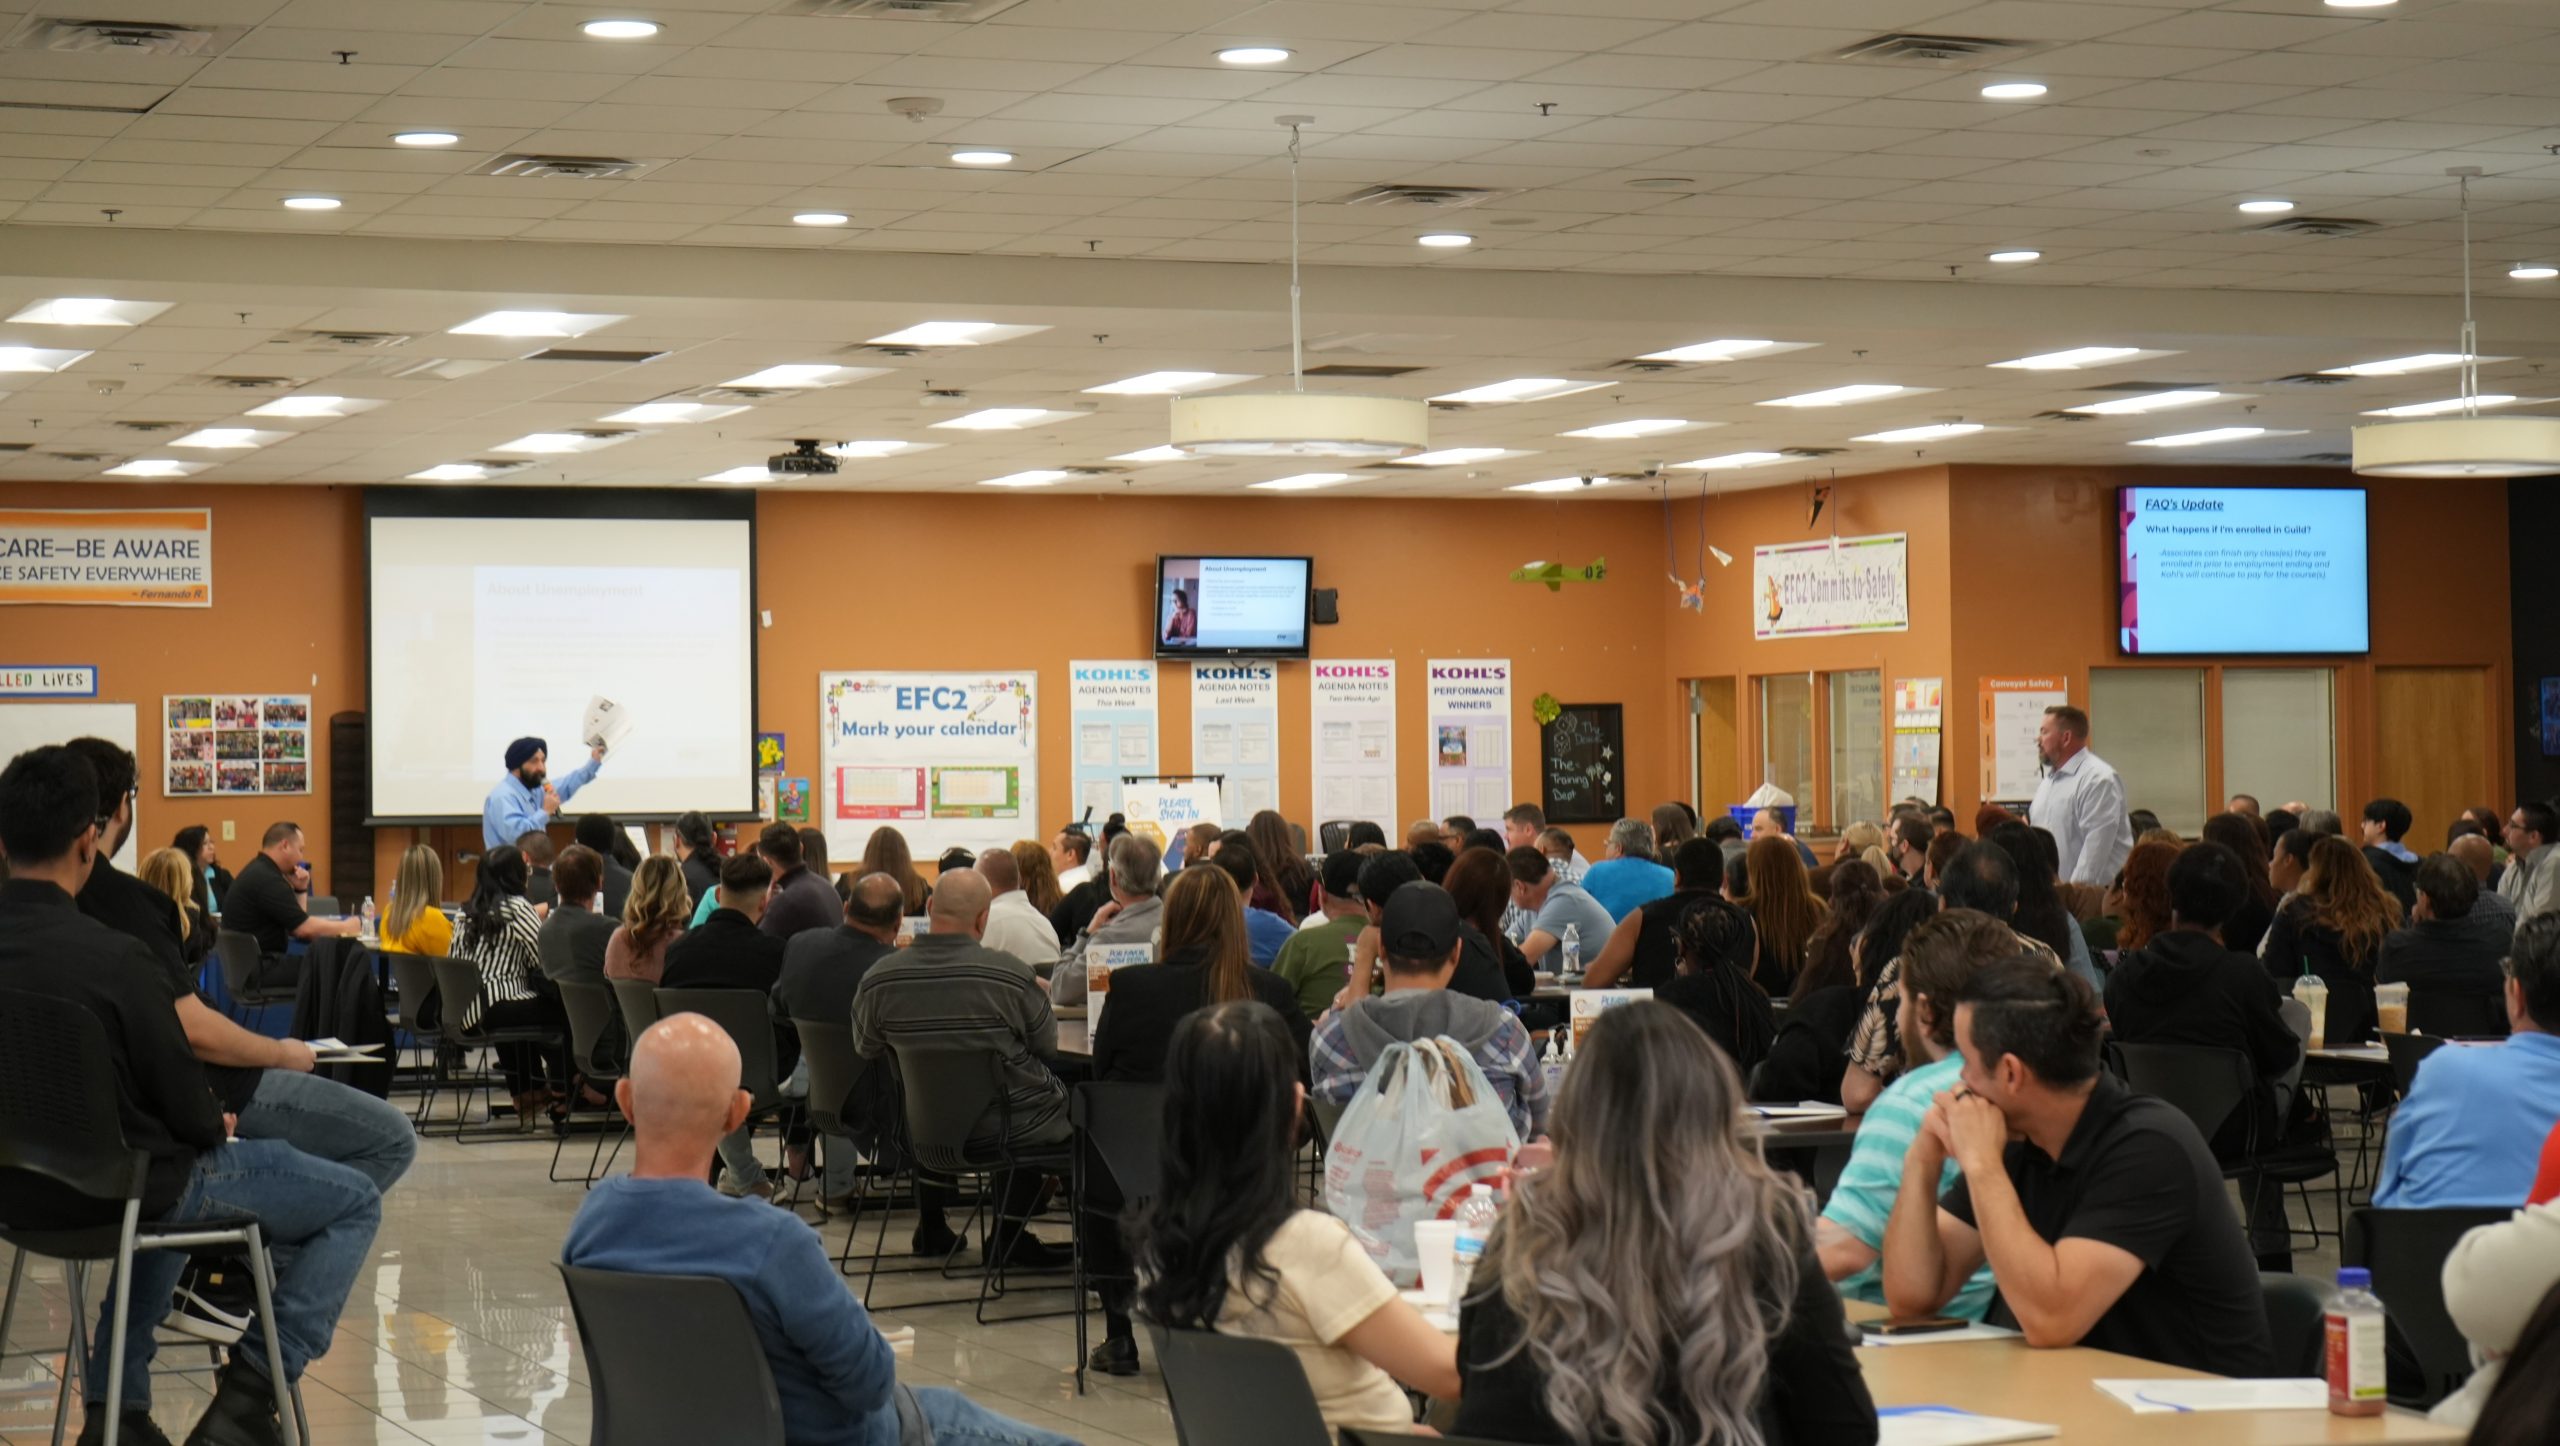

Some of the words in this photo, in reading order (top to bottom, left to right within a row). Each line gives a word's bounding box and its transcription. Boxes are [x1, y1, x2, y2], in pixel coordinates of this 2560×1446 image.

[2145, 498, 2179, 511] FAQ's
[2181, 498, 2224, 512] Update
[2146, 525, 2169, 534] What
[2172, 524, 2210, 536] happens
[2212, 524, 2218, 533] if
[2220, 525, 2234, 534] I'm
[2235, 524, 2271, 535] enrolled
[2273, 525, 2281, 534] in
[2283, 524, 2312, 535] Guild?
[113, 538, 201, 559] AWARE
[2294, 548, 2312, 560] they
[2233, 559, 2283, 569] employment
[2285, 559, 2313, 570] ending
[2314, 559, 2331, 569] and
[18, 566, 81, 581] SAFETY
[86, 566, 202, 582] EVERYWHERE
[1783, 571, 1809, 605] EFC2
[1810, 571, 1850, 604] Commits
[1853, 570, 1863, 601] to
[1866, 565, 1897, 606] Safety
[140, 588, 192, 600] Fernando
[1074, 668, 1152, 681] KOHL'S
[1196, 667, 1272, 680] KOHL'S
[1315, 665, 1391, 678] KOHL'S
[1431, 667, 1507, 679] KOHL'S
[1078, 685, 1118, 695] AGENDA
[1120, 685, 1151, 694] NOTES
[1199, 683, 1238, 692] AGENDA
[1239, 682, 1270, 691] NOTES
[1318, 682, 1357, 691] AGENDA
[1358, 682, 1389, 690] NOTES
[1990, 679, 2027, 689] Conveyor
[2028, 679, 2055, 689] Safety
[1434, 686, 1506, 696] PERFORMANCE
[896, 686, 968, 711] EFC2
[1448, 700, 1493, 710] WINNERS
[842, 721, 889, 736] Mark
[895, 724, 935, 739] your
[940, 721, 1017, 737] calendar
[1551, 772, 1589, 789] Training
[1159, 797, 1193, 809] PLEASE
[1160, 808, 1185, 820] SIGN
[1187, 807, 1199, 819] IN
